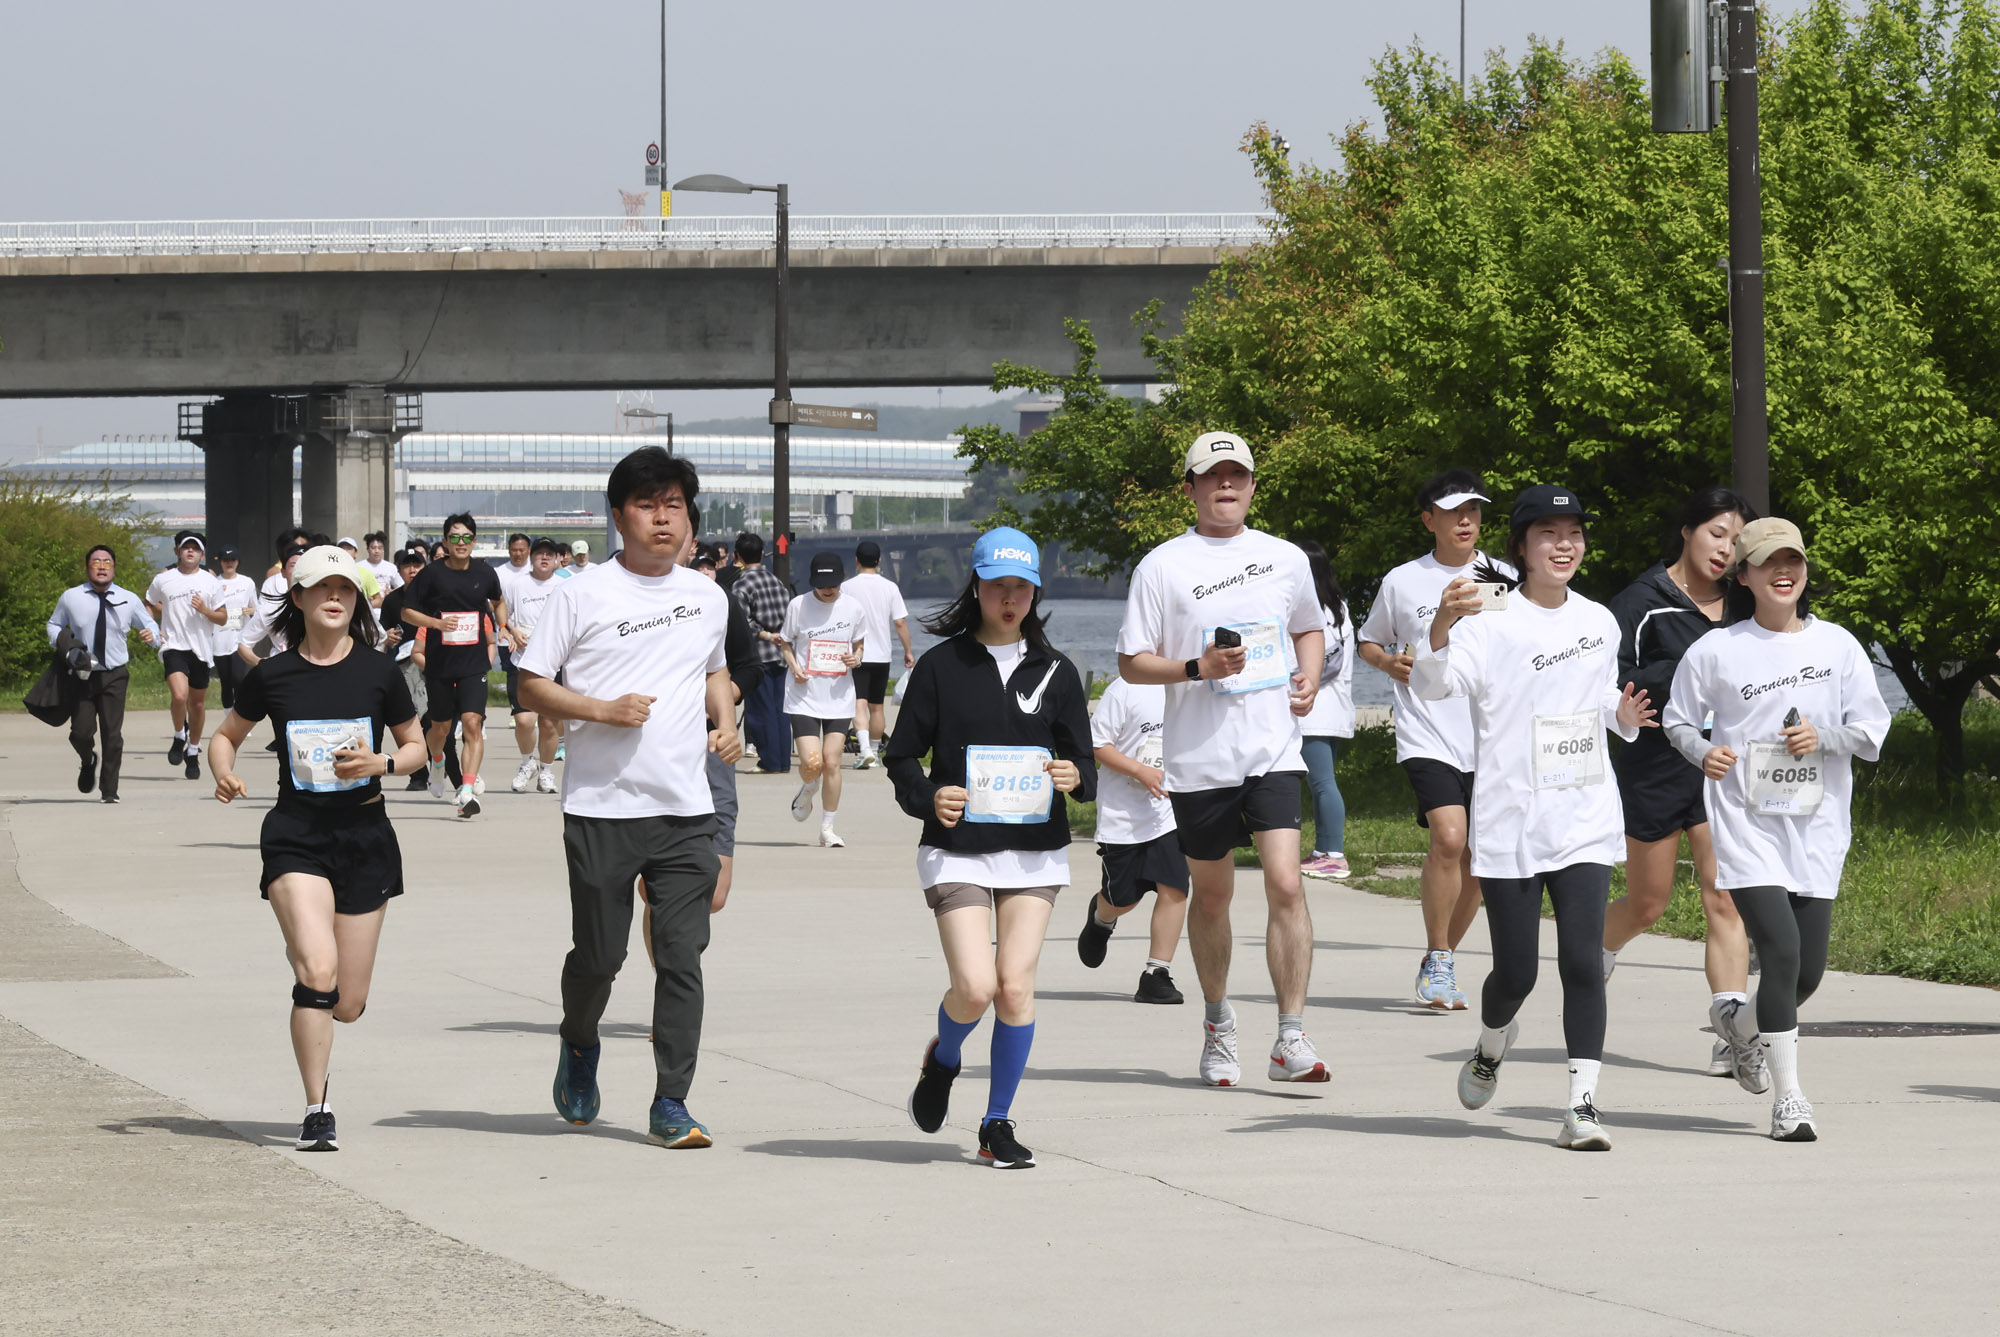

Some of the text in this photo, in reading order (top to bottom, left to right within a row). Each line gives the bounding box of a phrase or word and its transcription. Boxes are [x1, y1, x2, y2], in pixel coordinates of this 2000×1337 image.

[649, 150, 657, 159] 60
[797, 408, 813, 416] 여의도
[993, 547, 1032, 565] HOKA
[1192, 574, 1245, 600] Burning
[1245, 563, 1274, 579] Run
[616, 621, 672, 637] Burning
[672, 605, 702, 621] Run
[807, 621, 851, 639] Burning Run
[1245, 644, 1274, 662] 083
[1531, 643, 1580, 671] Burning
[1578, 636, 1604, 653] Run
[1740, 666, 1832, 700] Burning Run
[297, 750, 309, 760] W
[1542, 736, 1594, 756] W 6086
[1142, 756, 1152, 765] M
[977, 775, 1042, 791] W 8165
[1542, 773, 1566, 783] E-211
[1757, 766, 1818, 783] W 6085
